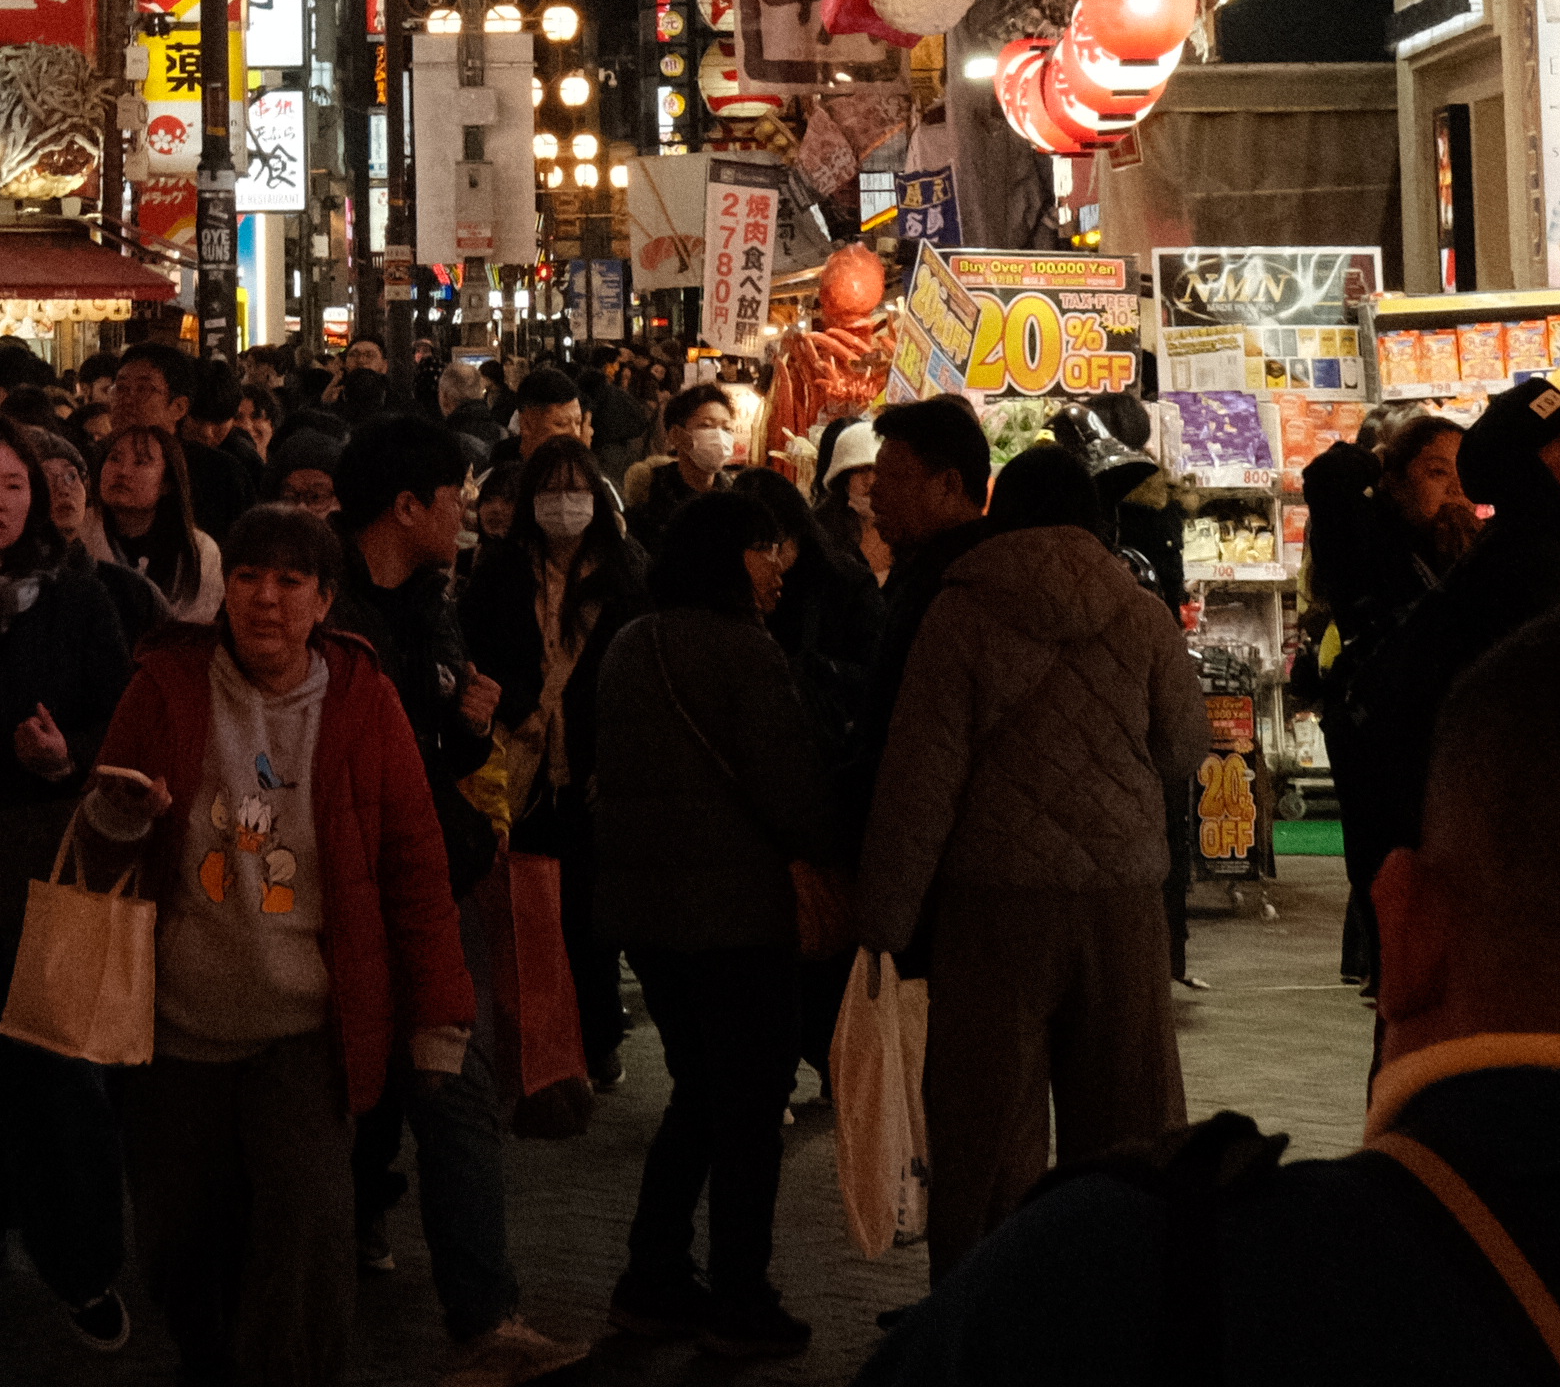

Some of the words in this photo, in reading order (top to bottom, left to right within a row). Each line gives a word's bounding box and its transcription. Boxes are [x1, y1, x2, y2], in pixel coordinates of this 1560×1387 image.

[736, 191, 772, 347] 焼肉食べ放題
[958, 260, 989, 276] Buy
[990, 261, 1025, 275] Over
[1088, 263, 1116, 276] Yen
[1179, 273, 1290, 304] NMN
[1064, 355, 1135, 392] OFF
[1242, 470, 1270, 485] 800
